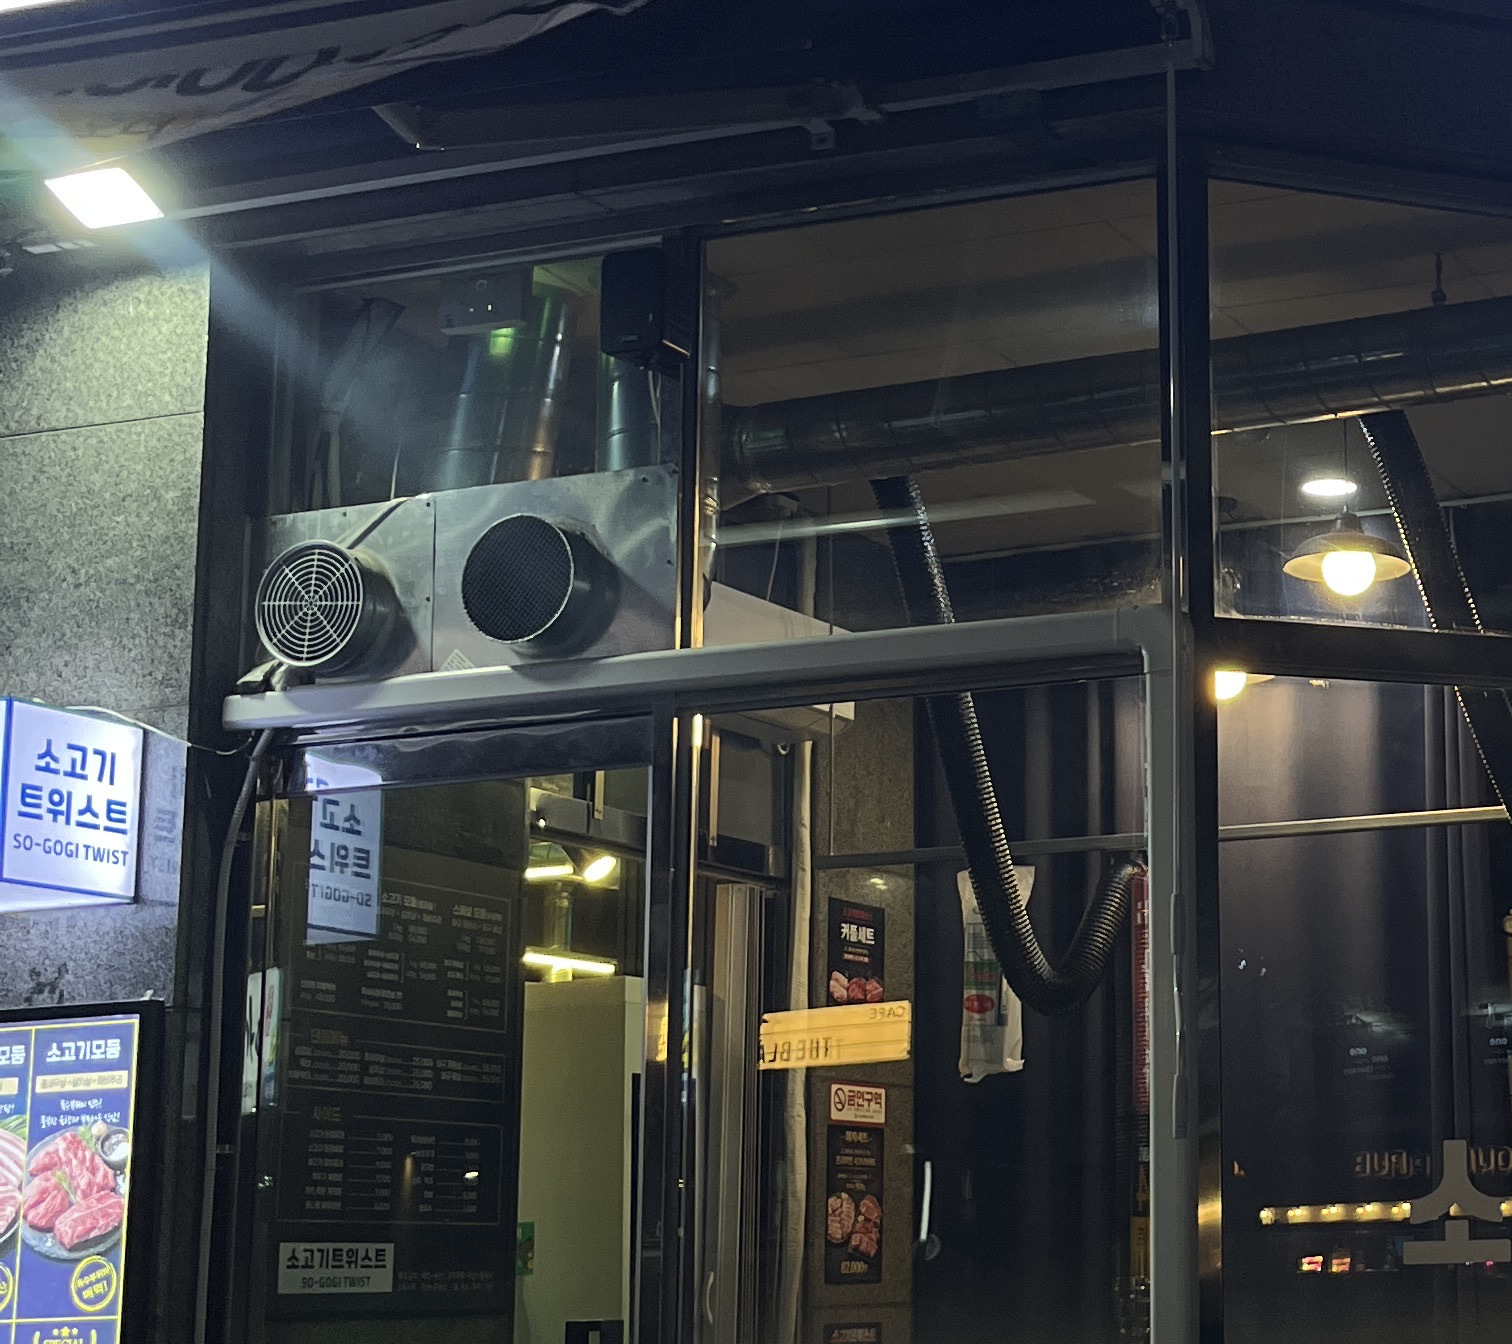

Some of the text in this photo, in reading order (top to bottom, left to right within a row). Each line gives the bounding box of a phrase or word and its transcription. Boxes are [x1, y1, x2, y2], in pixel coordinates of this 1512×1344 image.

[34, 737, 117, 786] 소고기
[17, 782, 129, 836] 트위스트
[13, 834, 129, 868] SO-GOGI TWIST
[45, 1038, 122, 1063] 소고기모둠
[847, 1089, 883, 1110] 금연구역
[286, 1247, 388, 1270] 소고기트위스트
[301, 1276, 372, 1289] SO-GOGI TWIST
